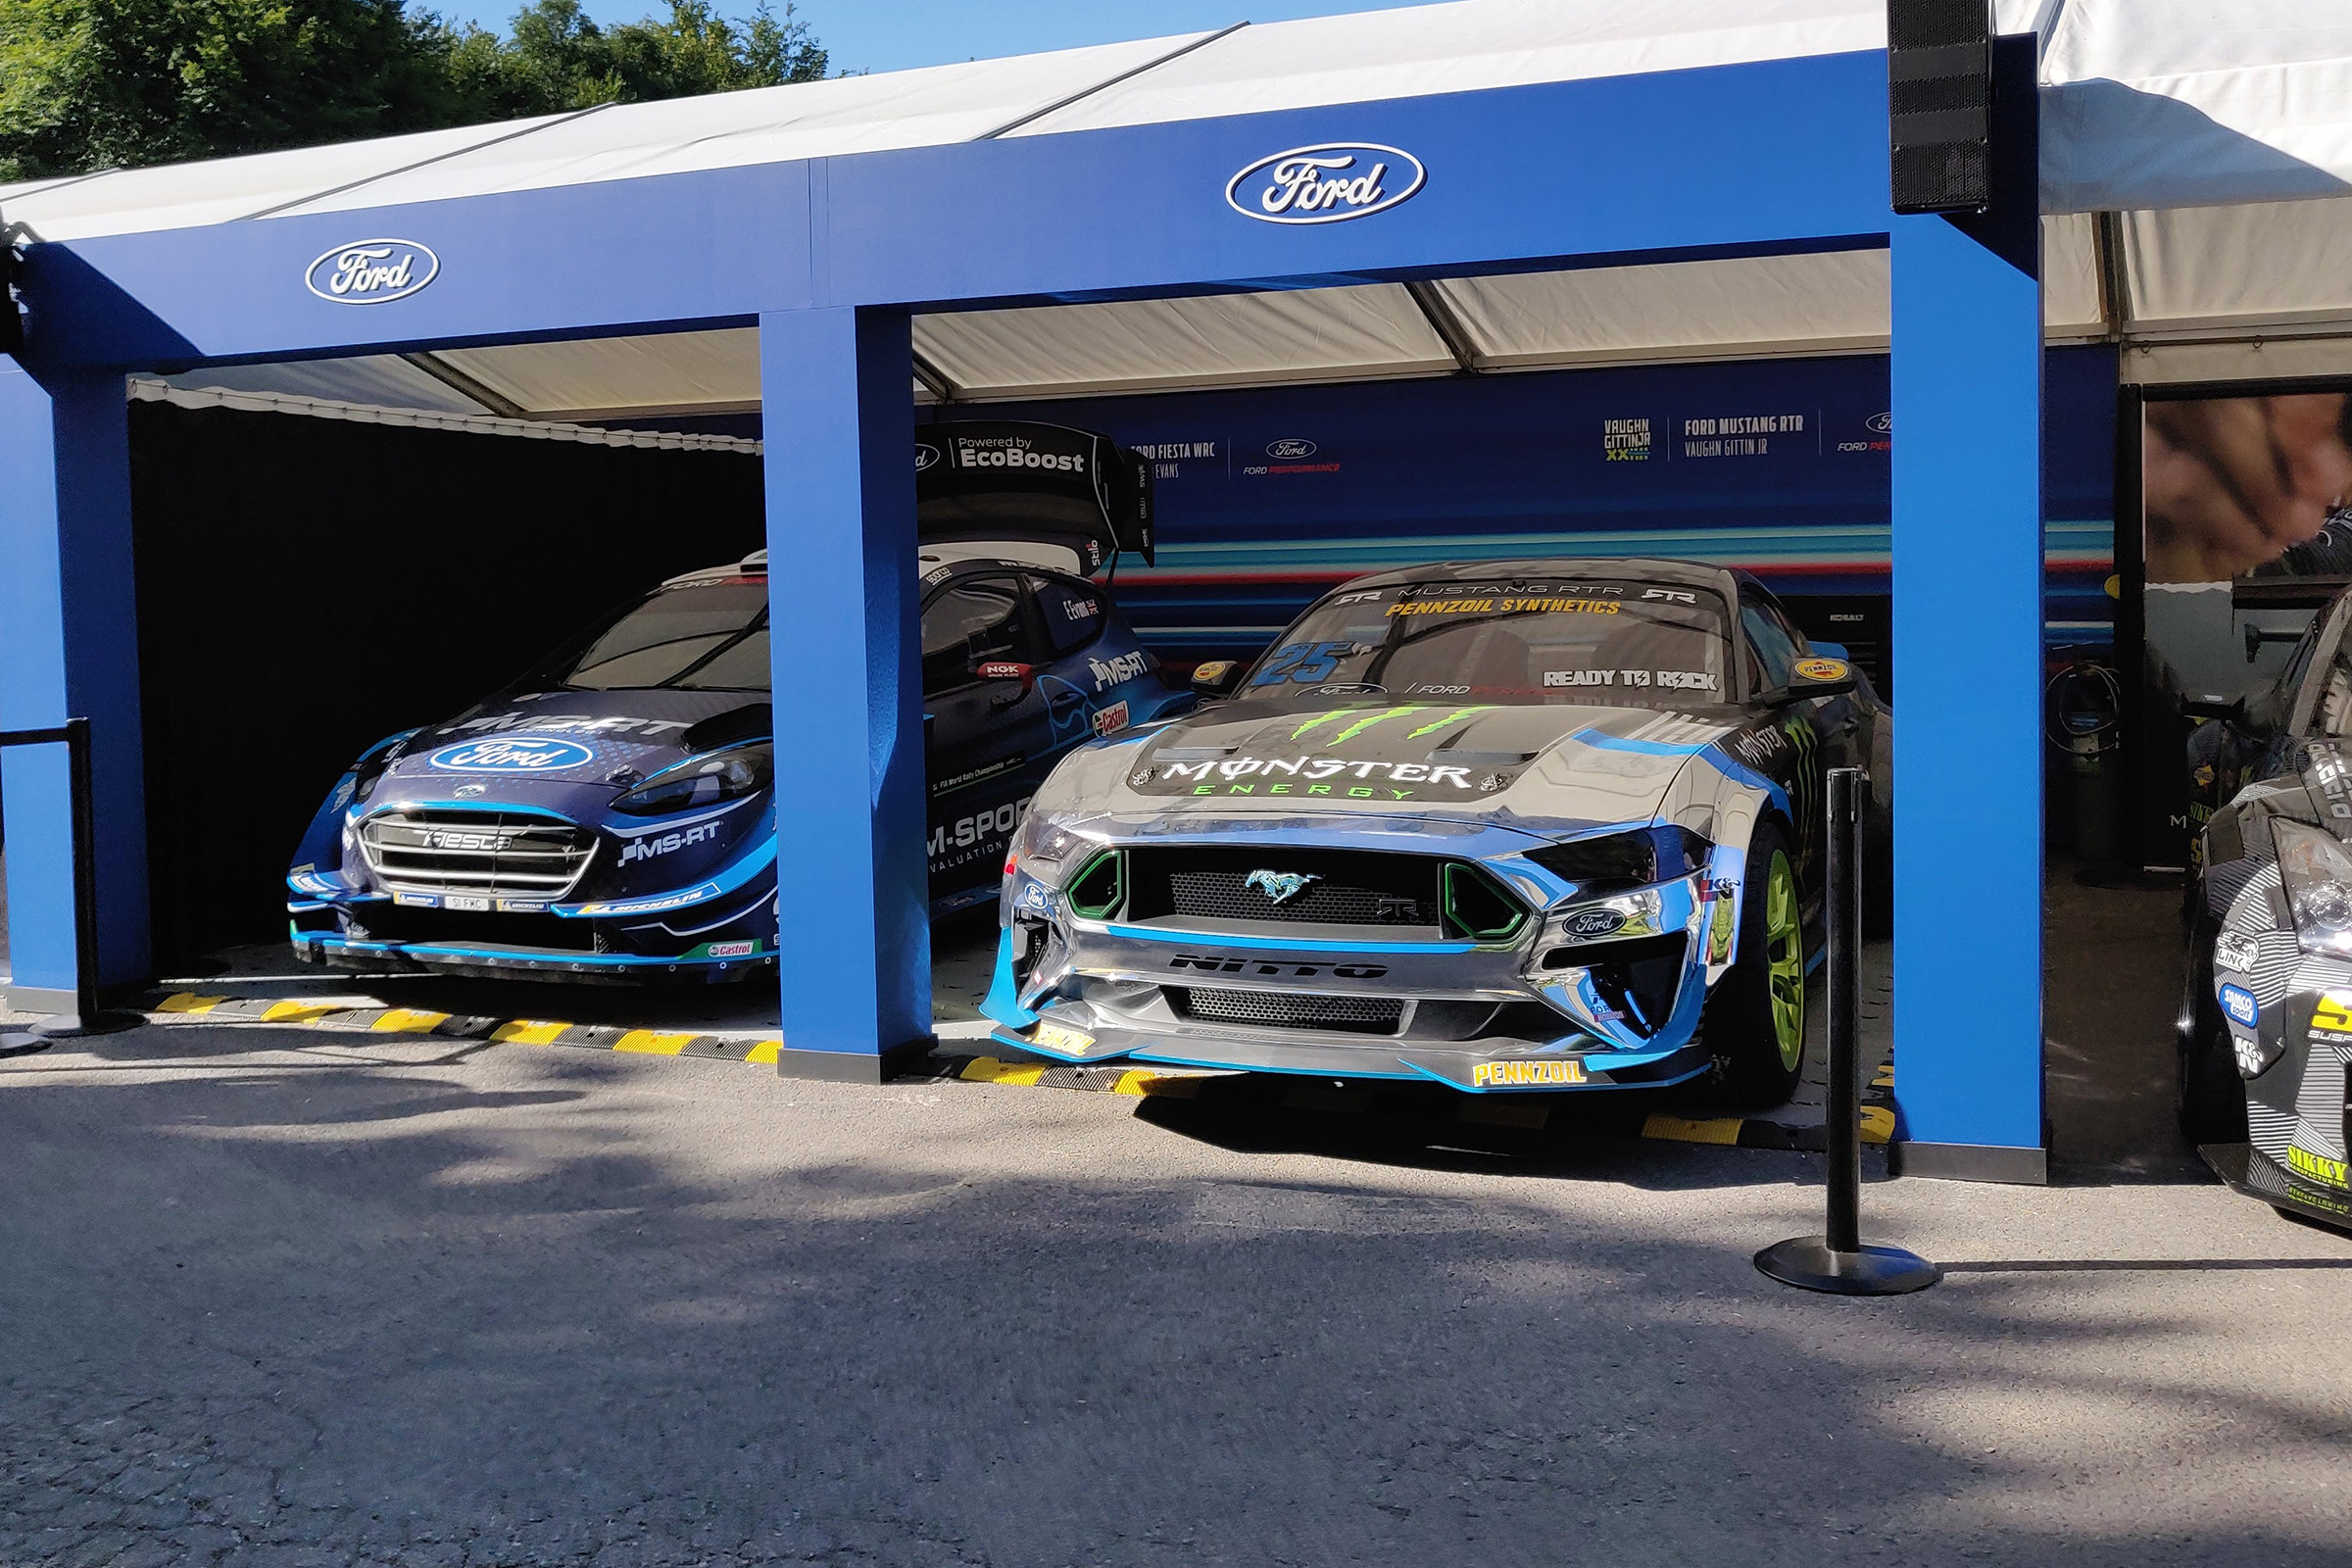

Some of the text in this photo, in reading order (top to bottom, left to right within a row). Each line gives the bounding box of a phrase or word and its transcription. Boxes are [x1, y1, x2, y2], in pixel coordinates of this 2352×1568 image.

[1262, 155, 1388, 213] Ford
[329, 248, 416, 295] Ford
[1604, 418, 1649, 434] VAUGHN
[1685, 415, 1804, 436] FORD MUSTANG RTR
[957, 436, 1032, 450] Powered by
[1131, 442, 1215, 461] ORD FIESTA WRC
[1275, 441, 1307, 457] Ford
[1685, 438, 1768, 458] VAUGHN GITTIN JR
[1837, 441, 1867, 452] FORD
[960, 448, 1084, 472] EcoBoost
[1155, 463, 1179, 479] EVANS
[1243, 466, 1267, 475] FORD
[1396, 585, 1625, 598] MUSTANG RTR
[1384, 598, 1621, 617] PENNZOIL SYNTHETICS
[986, 664, 1019, 674] NGK
[1250, 641, 1355, 686] 25
[1804, 663, 1838, 673] PENNZOIL
[1544, 670, 1617, 687] READY
[1418, 685, 1472, 695] FORD
[1102, 706, 1128, 732] Castrol
[450, 740, 568, 767] Ford
[1194, 784, 1414, 801] ENERGY
[926, 797, 1032, 858] M-SPOR
[635, 820, 720, 861] MS-RT
[929, 840, 1003, 874] VALUATION
[613, 891, 703, 912] MICHELIN
[1029, 886, 1044, 906] Ford
[1575, 913, 1613, 933] Ford
[719, 944, 752, 956] Castrol
[2218, 950, 2243, 968] LINK
[1168, 953, 1389, 979] NITTO
[2224, 989, 2252, 1009] SAMCO
[2231, 1005, 2251, 1019] sport
[1472, 1059, 1588, 1088] PENNZOIL
[2287, 1144, 2348, 1182] SIKKY
